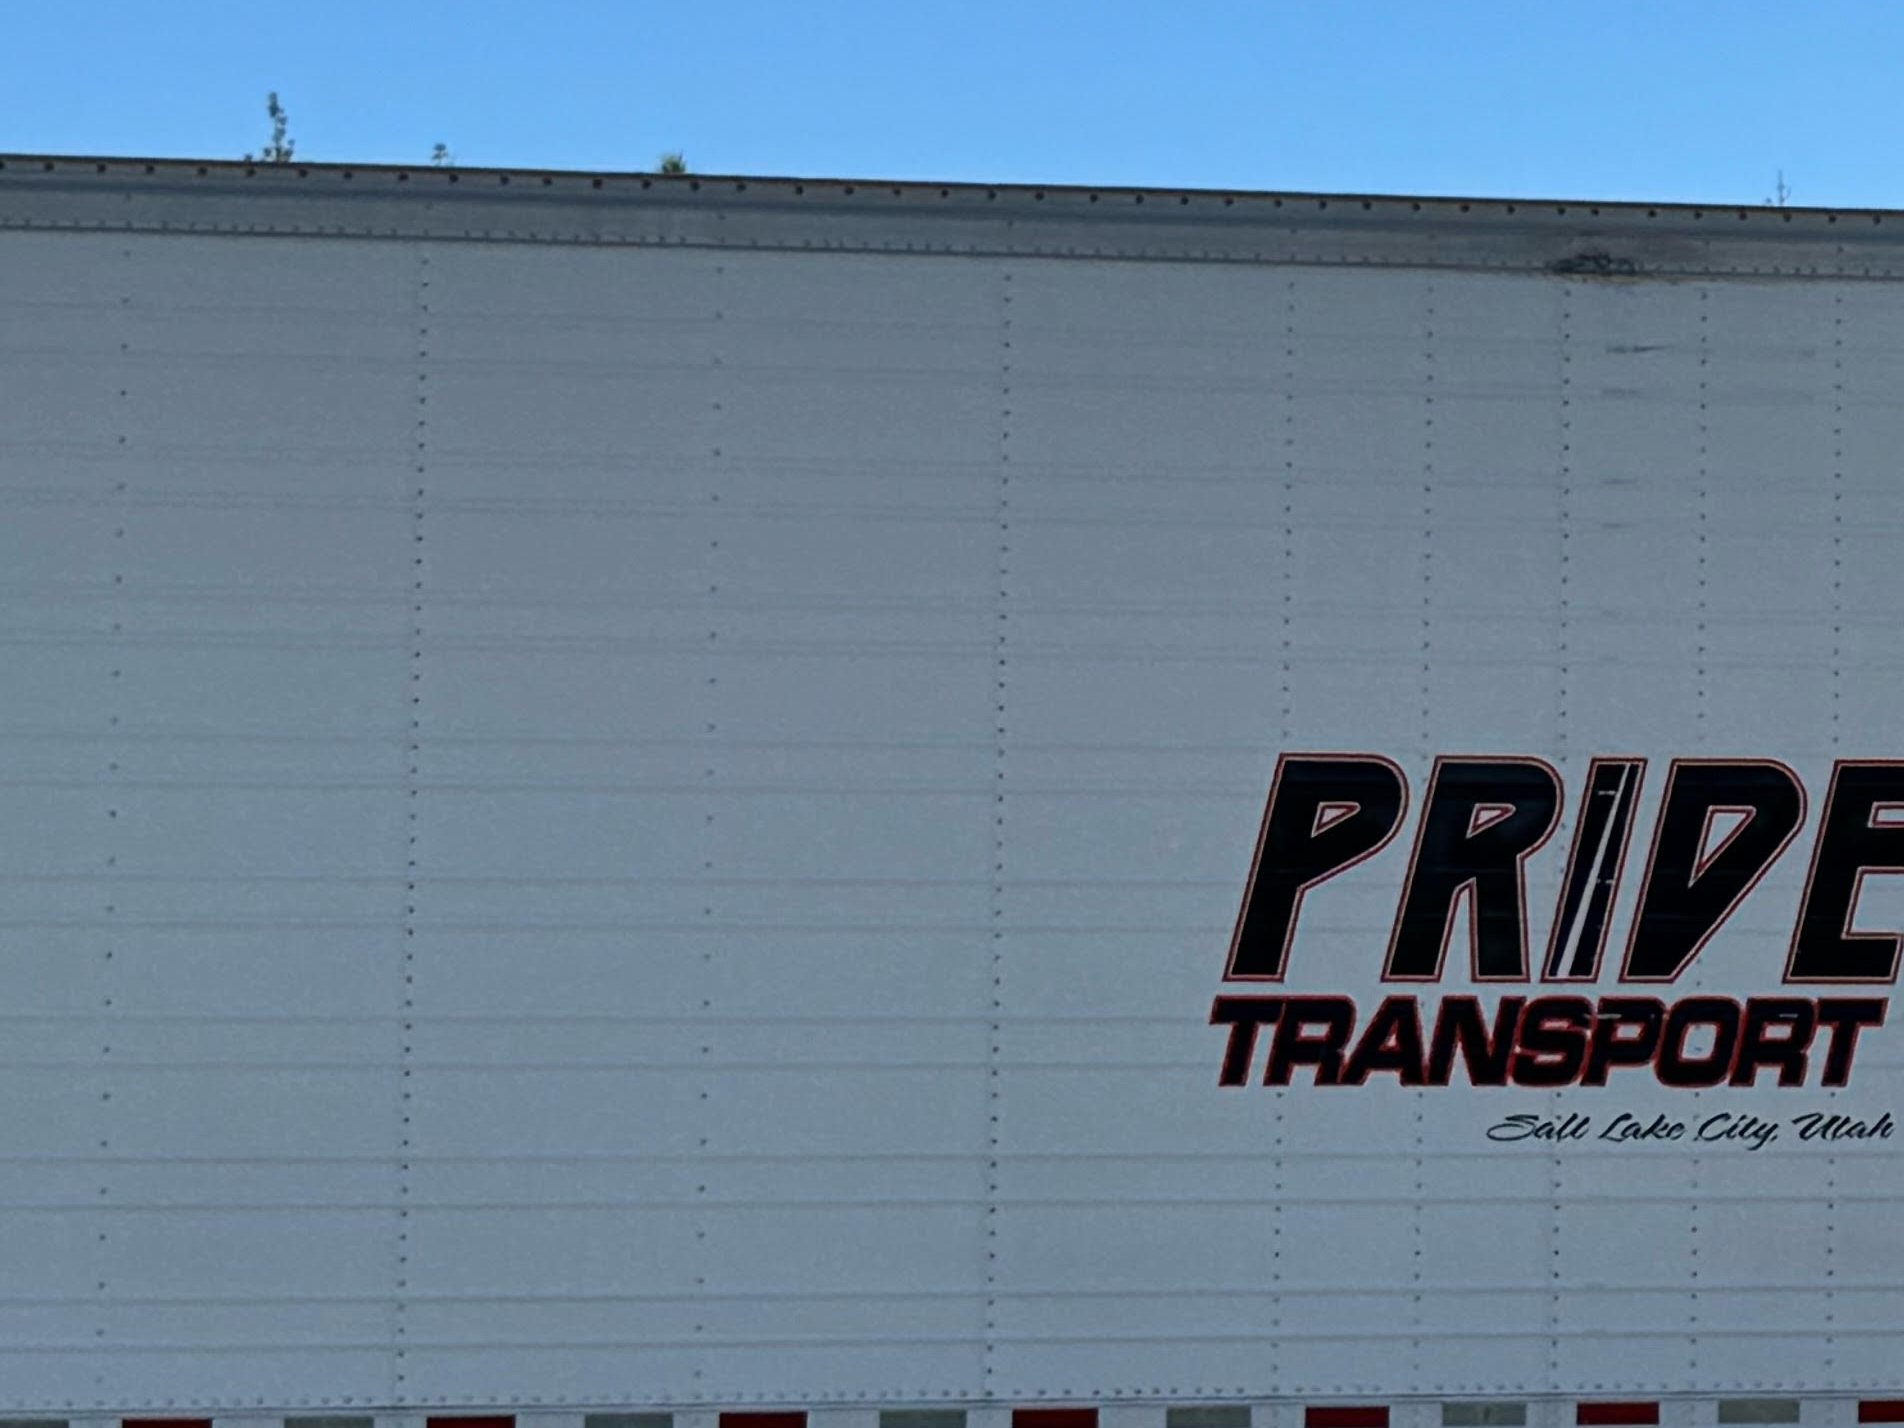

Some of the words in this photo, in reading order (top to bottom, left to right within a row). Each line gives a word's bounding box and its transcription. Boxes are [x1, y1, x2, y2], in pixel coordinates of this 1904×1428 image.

[1210, 994, 1889, 1088] TRANSPORT
[1486, 1113, 1592, 1143] Salt
[1598, 1113, 1687, 1141] Lake
[1697, 1113, 1780, 1151] City,
[1791, 1113, 1897, 1141] Utah
